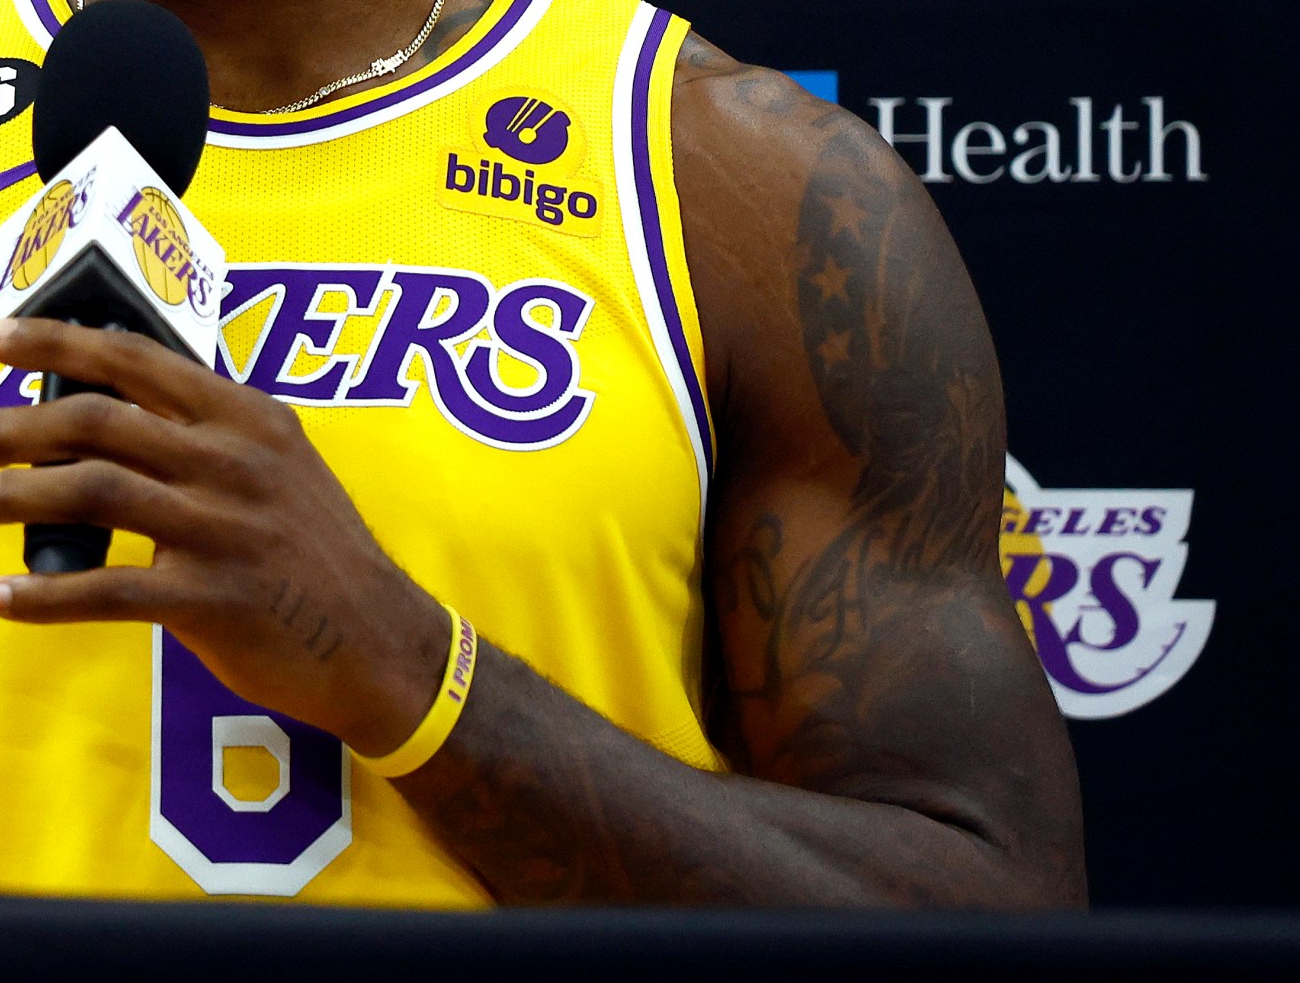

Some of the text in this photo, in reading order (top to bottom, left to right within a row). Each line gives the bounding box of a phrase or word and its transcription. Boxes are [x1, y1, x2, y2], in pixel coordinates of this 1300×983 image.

[867, 96, 1207, 184] Health
[148, 206, 168, 229] LOS
[445, 152, 597, 226] bibigo
[115, 190, 215, 318] LAKERS
